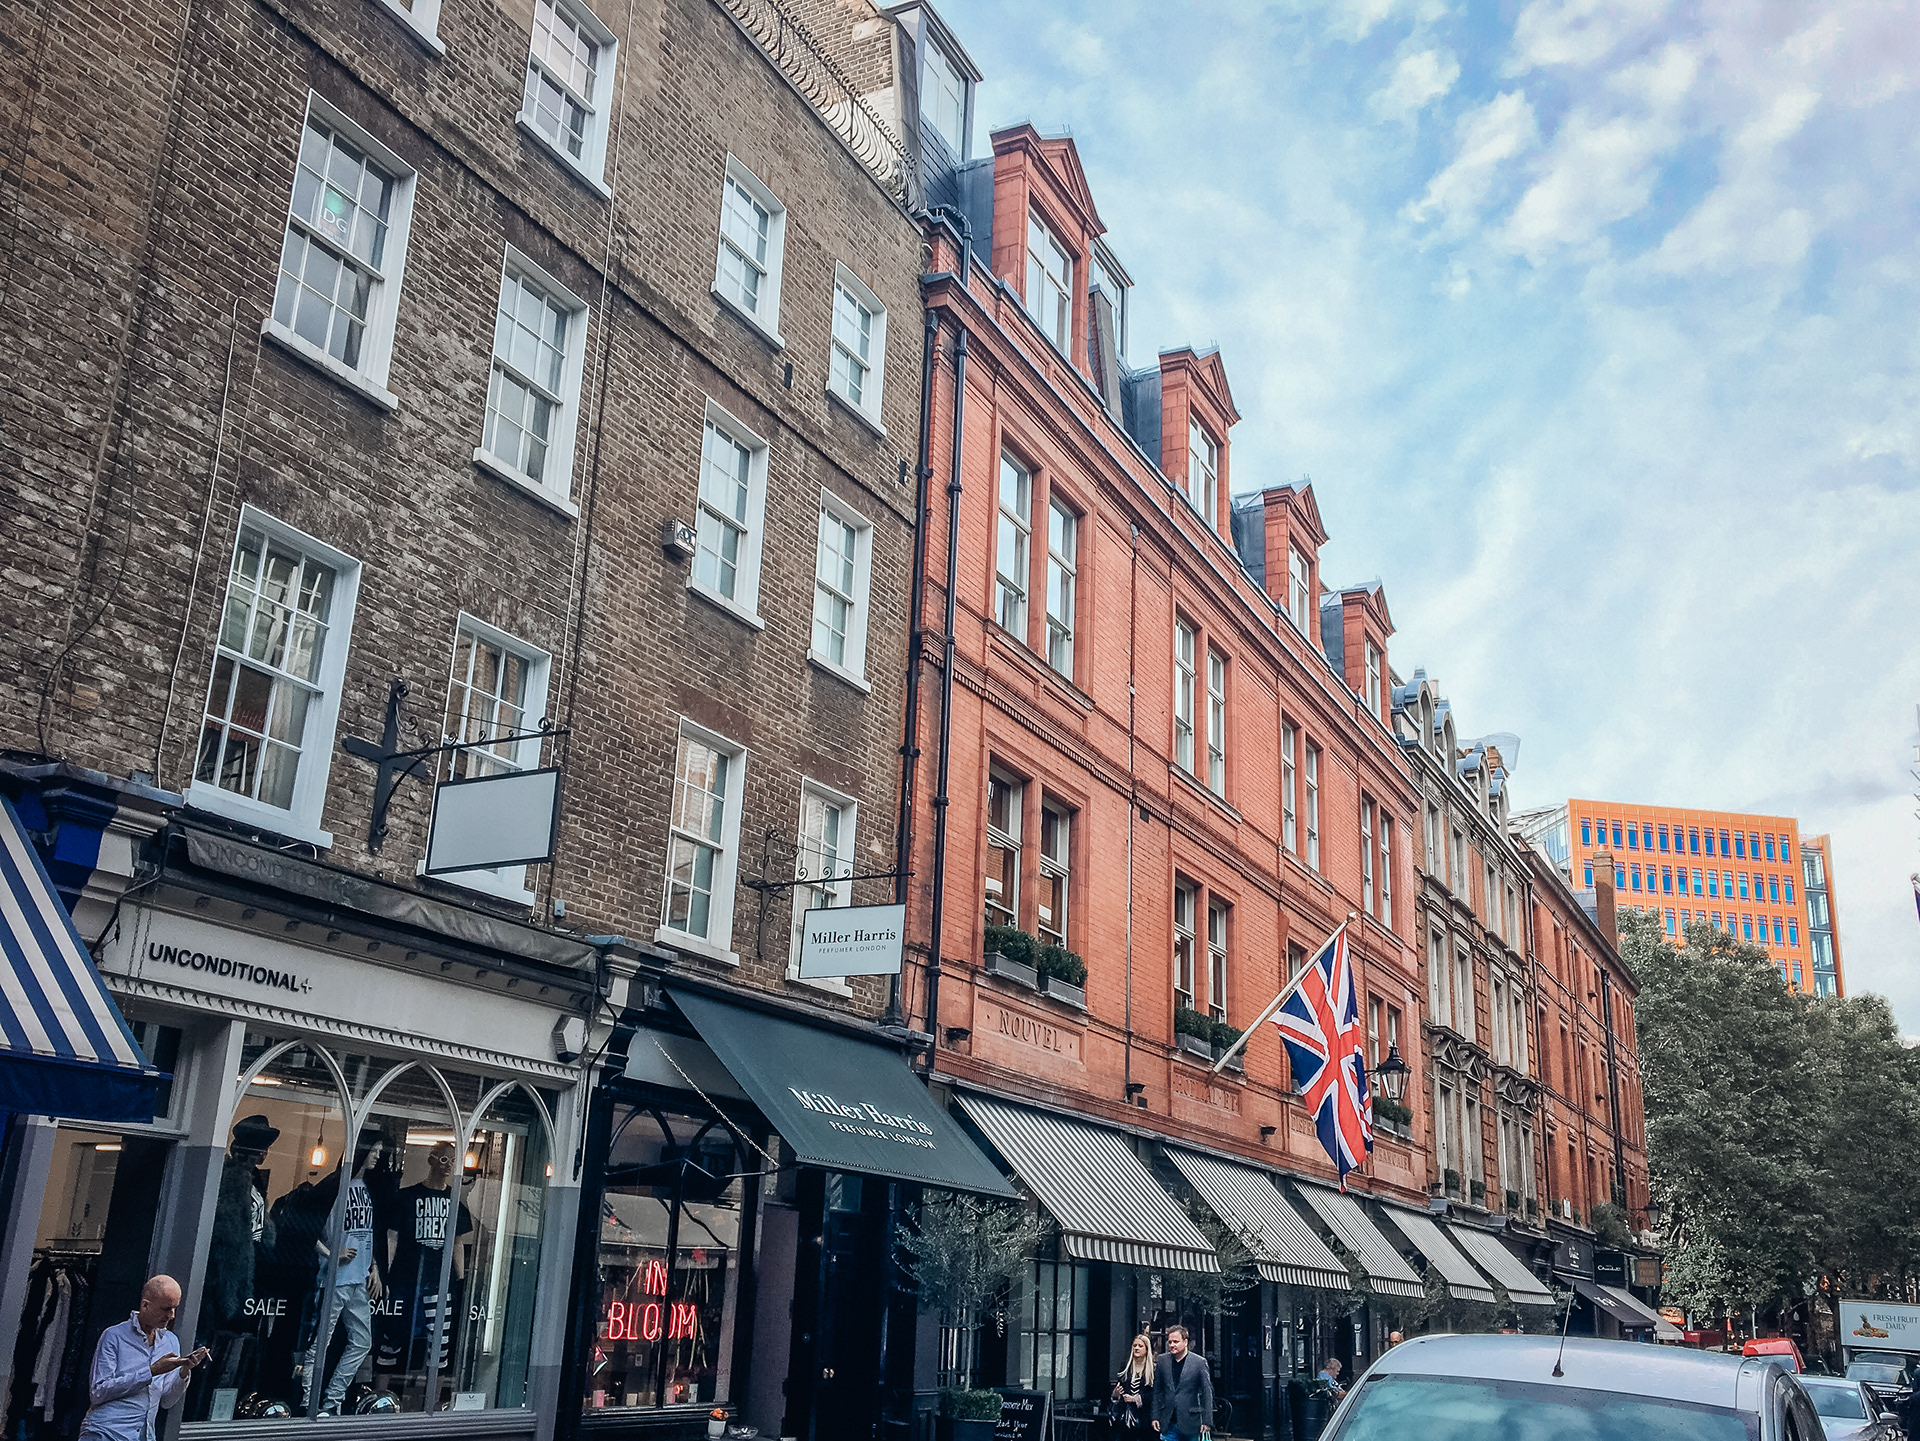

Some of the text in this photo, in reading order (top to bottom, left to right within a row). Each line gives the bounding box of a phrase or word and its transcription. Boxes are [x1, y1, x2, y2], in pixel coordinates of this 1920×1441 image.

[811, 928, 896, 945] Miller Harris
[819, 946, 852, 954] PERFUMER
[999, 1009, 1061, 1053] NOUVEL
[787, 1086, 934, 1136] Miller Harris
[828, 1120, 937, 1150] PERFUMER LONDON
[645, 1259, 668, 1296] IN
[243, 1298, 287, 1316] SALE
[367, 1299, 404, 1316] SALE
[469, 1305, 502, 1321] SALE
[1873, 1314, 1919, 1324] FRESH FRUIT
[1885, 1322, 1907, 1330] DAILY
